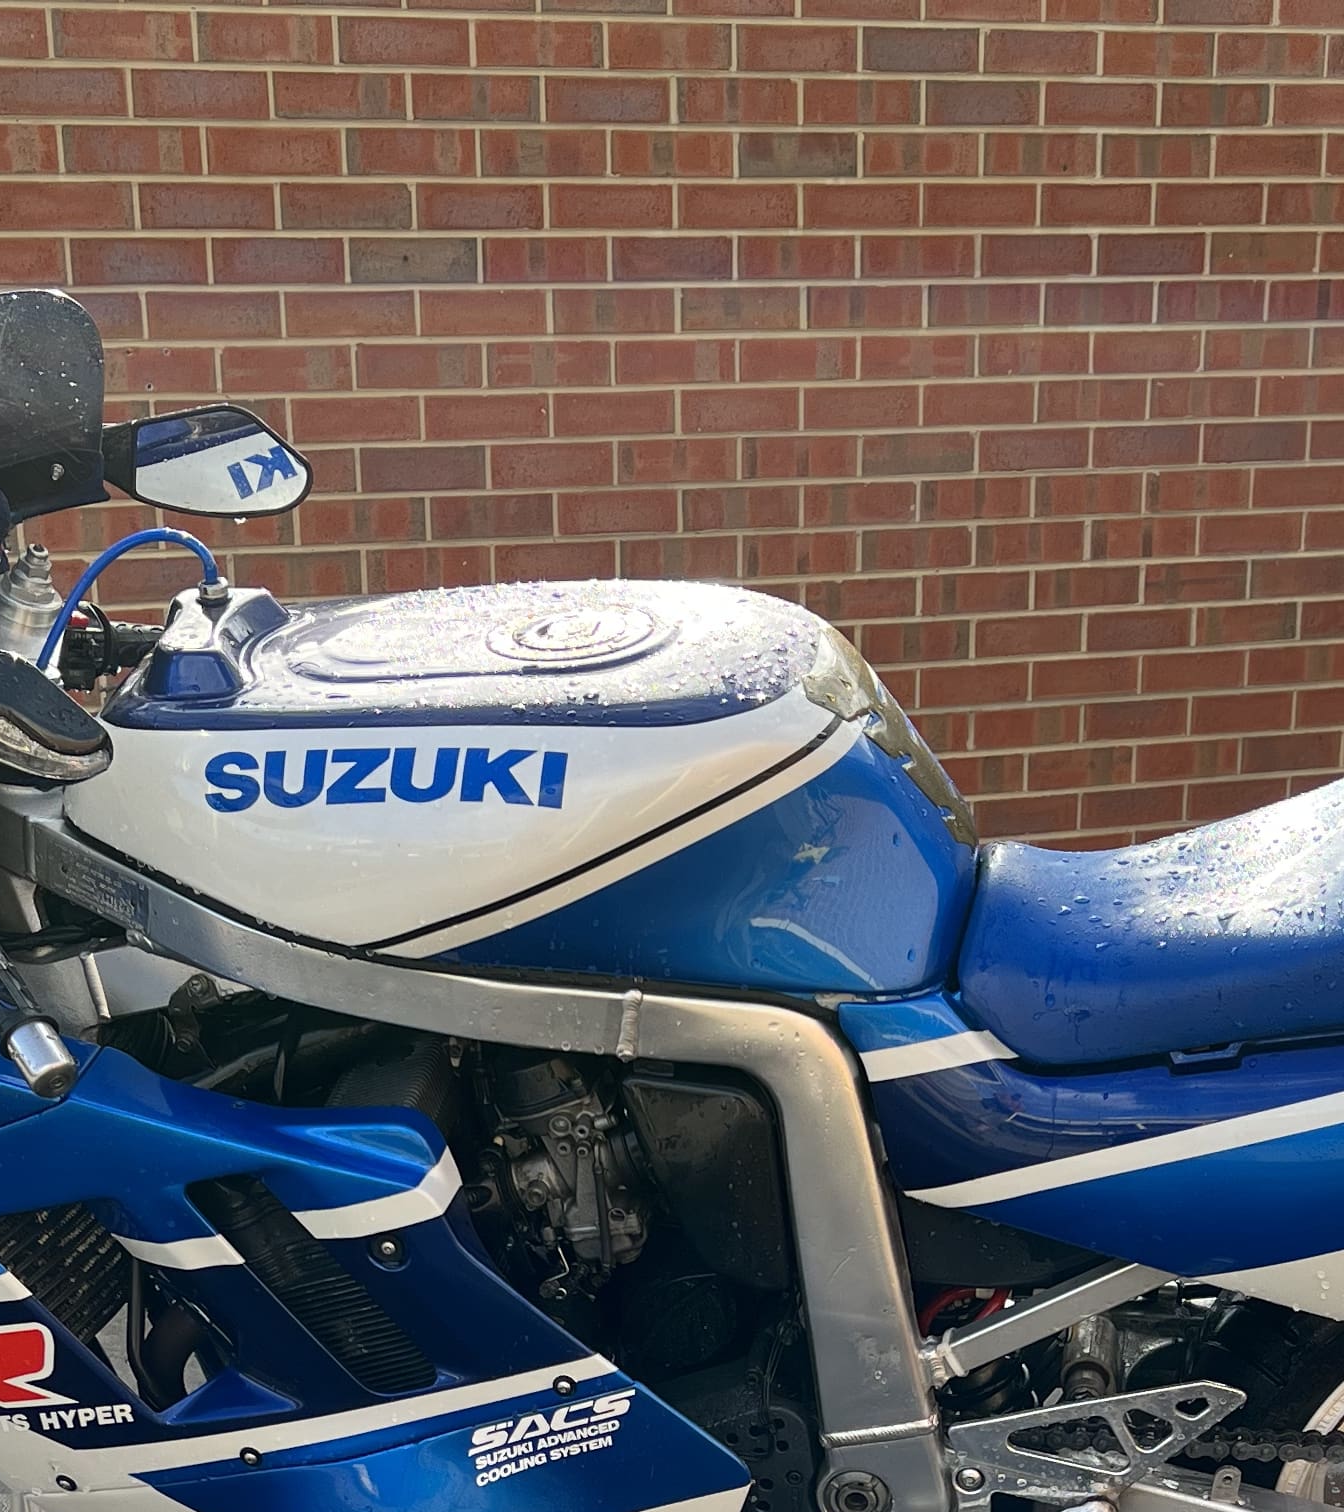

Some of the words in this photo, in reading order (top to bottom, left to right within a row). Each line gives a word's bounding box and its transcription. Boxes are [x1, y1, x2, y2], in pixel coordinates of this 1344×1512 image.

[205, 747, 568, 813] SUZUKI
[40, 1404, 134, 1431] HYPER
[468, 1389, 635, 1457] SACS
[475, 1441, 533, 1470] SUZUKI
[537, 1419, 620, 1451] ADVANCED
[476, 1453, 547, 1487] COOLING
[550, 1436, 613, 1461] SYSTEM
